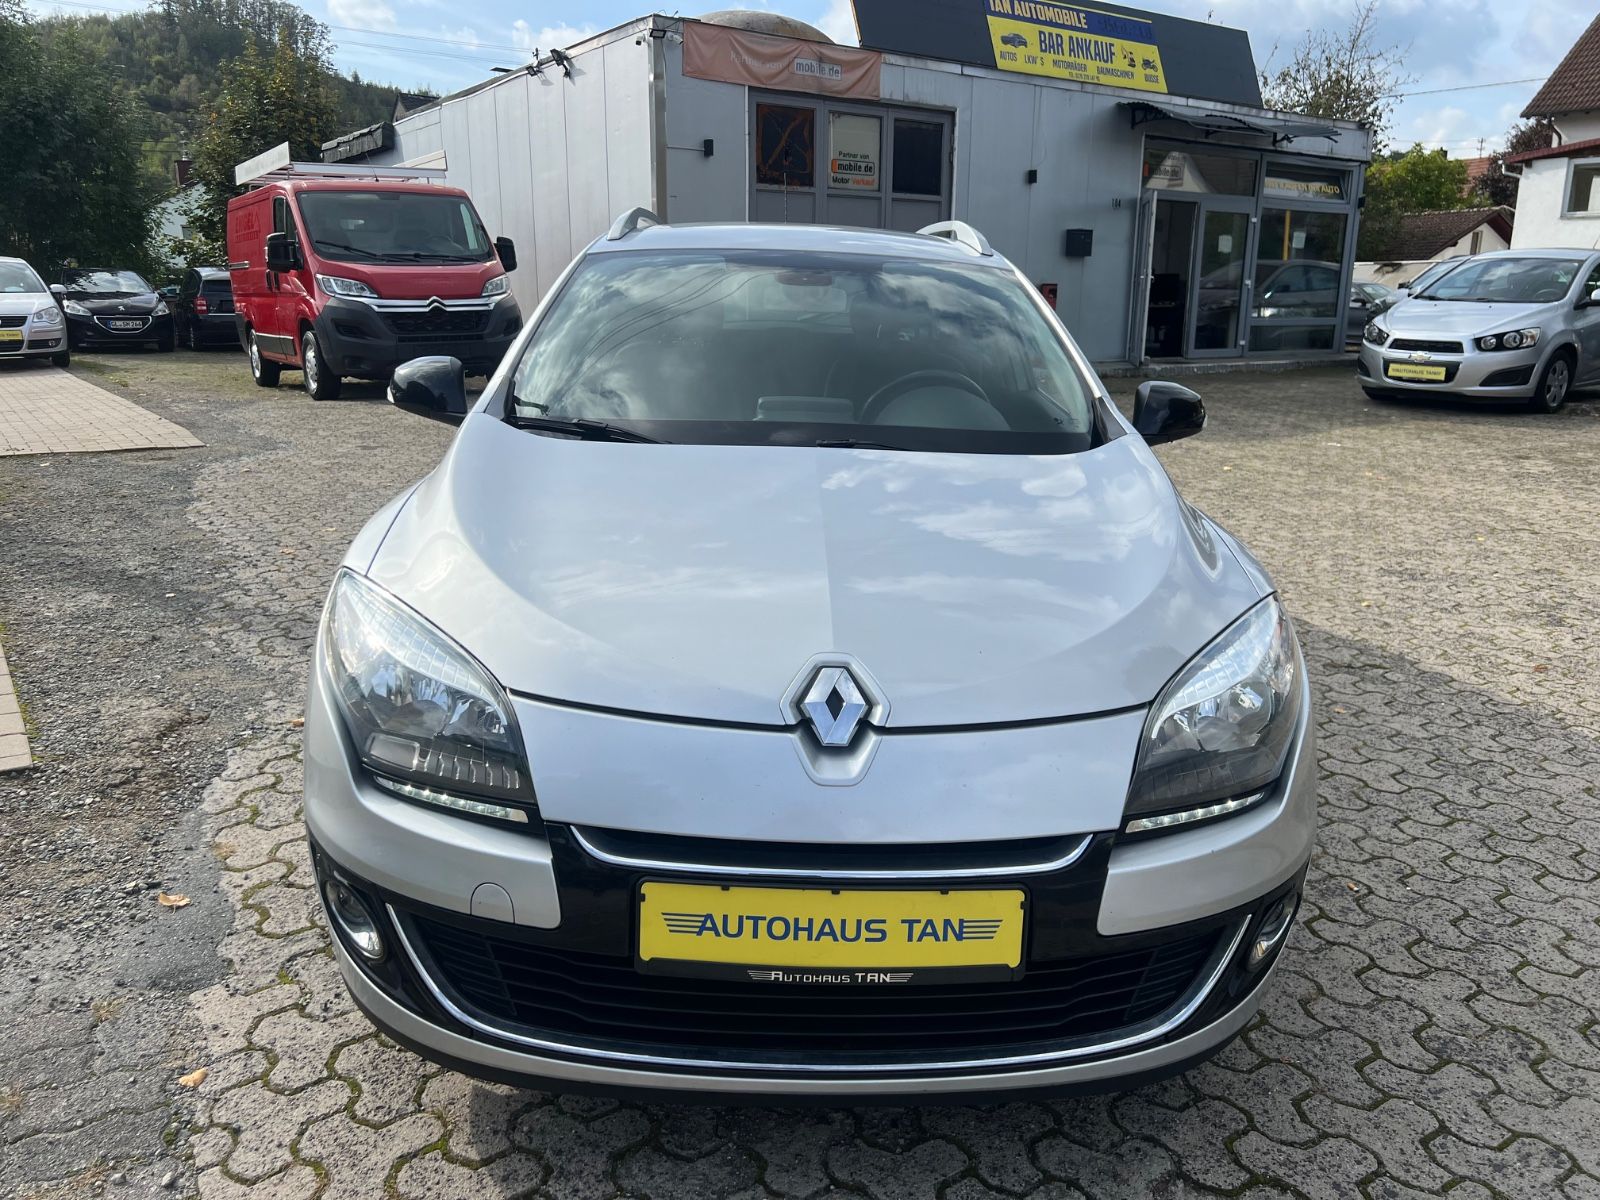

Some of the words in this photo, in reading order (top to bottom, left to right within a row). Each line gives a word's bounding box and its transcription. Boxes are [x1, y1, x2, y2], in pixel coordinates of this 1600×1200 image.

[1014, 0, 1088, 29] AUTOMOBILE
[1038, 30, 1064, 56] BAR
[1068, 37, 1116, 65] ANKAUF
[999, 50, 1018, 62] AUTOS
[795, 61, 840, 77] mobile.de
[838, 150, 859, 159] Partner
[832, 175, 850, 184] Motor
[1320, 184, 1340, 194] AUTO
[696, 913, 888, 943] AUTOHAUS
[901, 918, 965, 943] TAN
[854, 972, 891, 984] TAN
